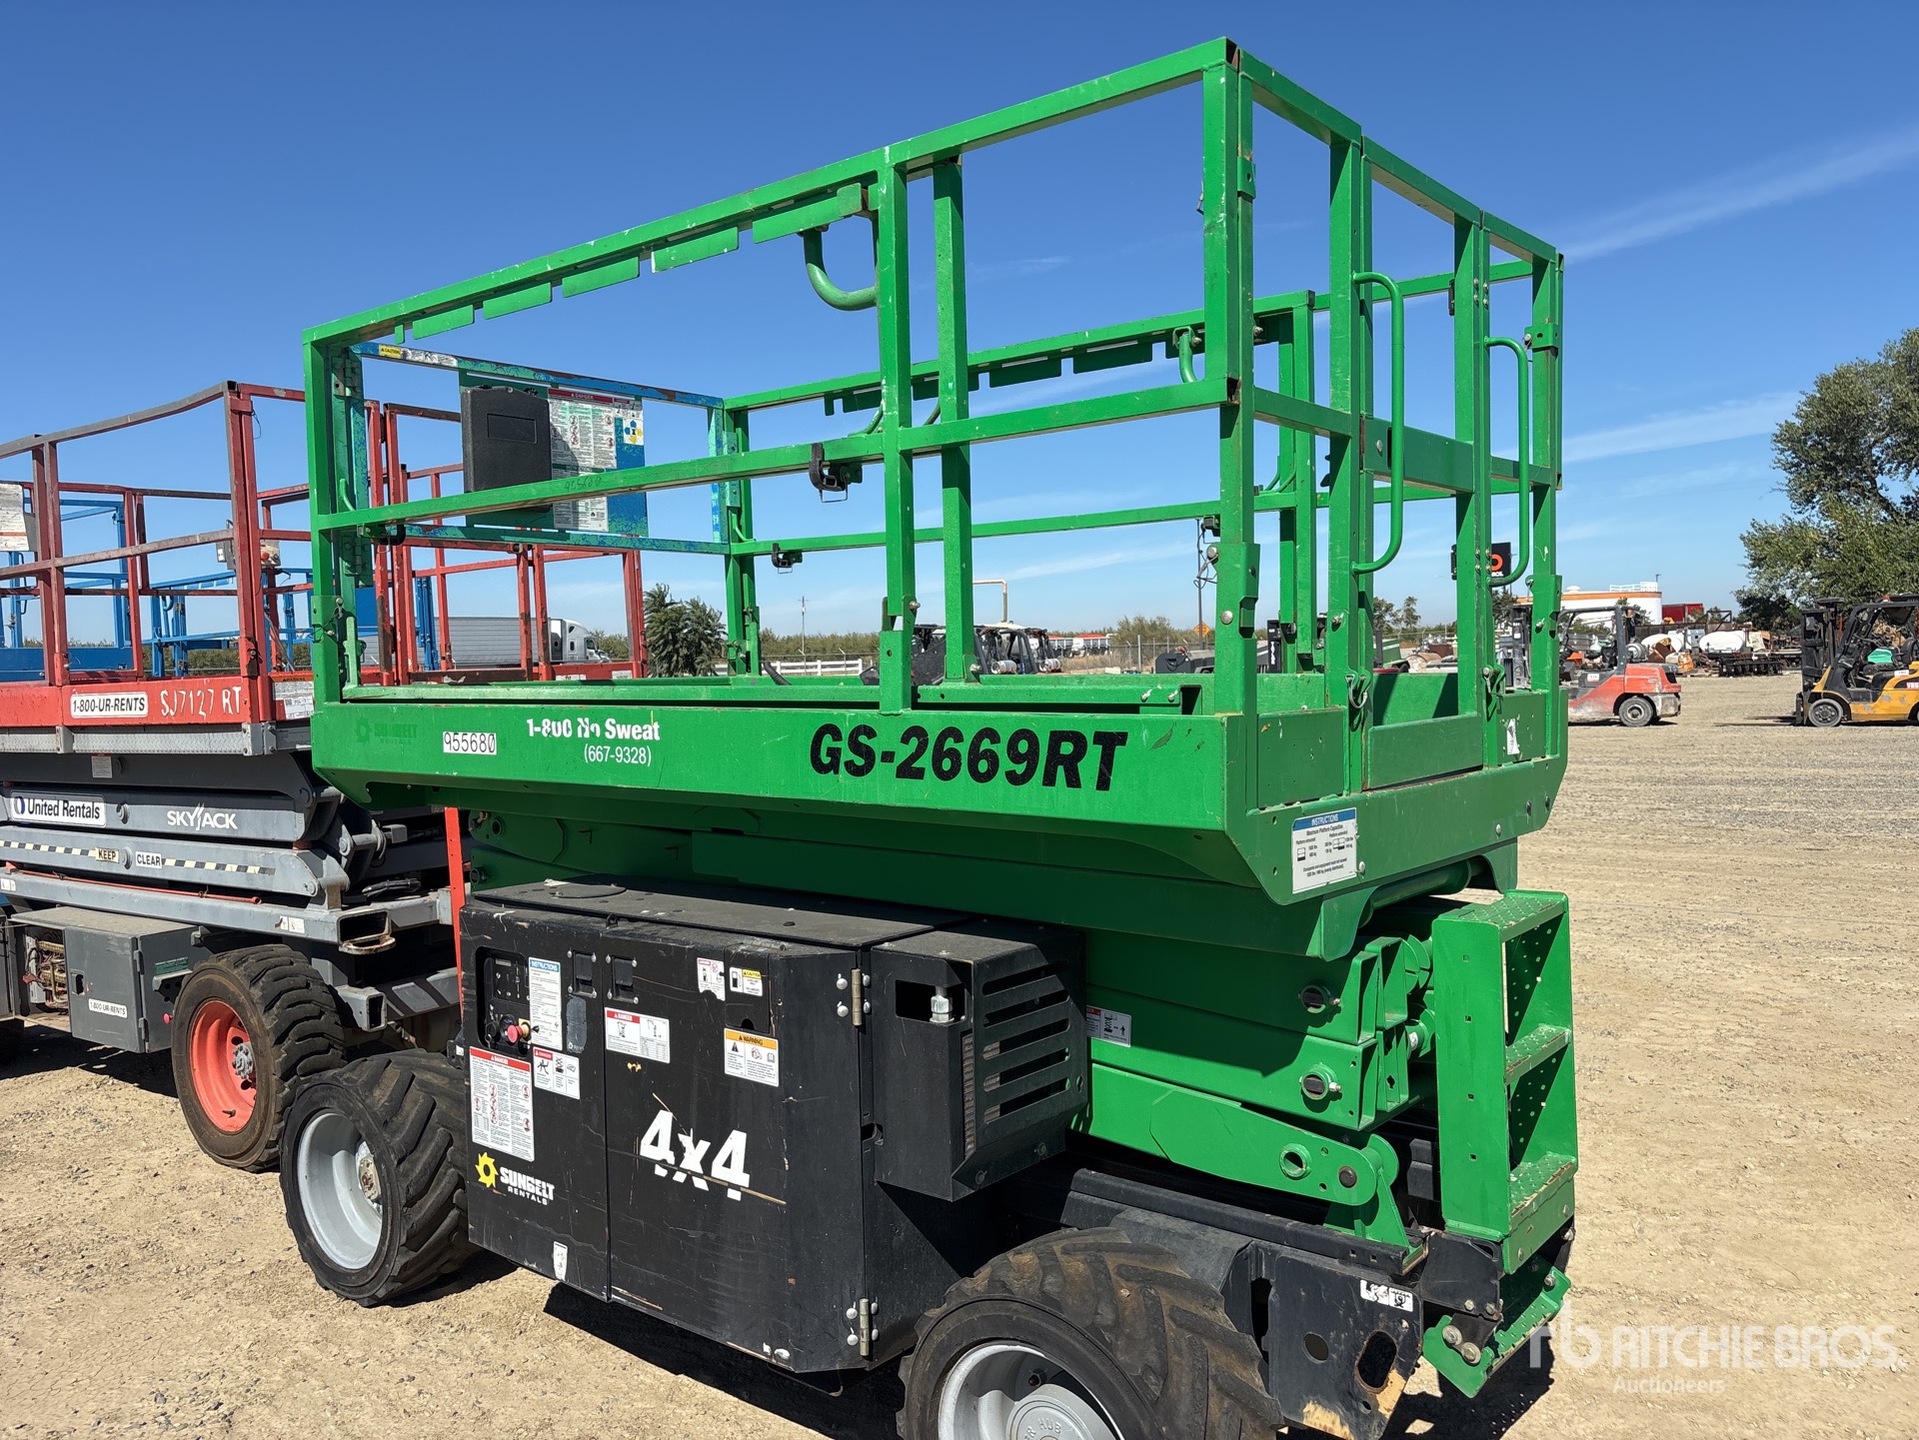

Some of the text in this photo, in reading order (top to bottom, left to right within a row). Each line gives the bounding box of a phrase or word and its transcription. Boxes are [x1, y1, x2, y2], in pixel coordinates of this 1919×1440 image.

[73, 697, 146, 713] 1-800-UR-RENTS
[160, 688, 214, 719] SJ7127
[222, 687, 242, 716] RT
[605, 718, 660, 741] Sweat
[444, 733, 496, 753] 955680
[584, 744, 652, 765] (667-9328)
[810, 723, 1129, 791] GS-2669RT
[28, 799, 100, 820] United Rentals
[167, 803, 238, 831] SKYJACK
[1311, 813, 1339, 826] INSTRUCTIONS
[99, 849, 117, 860] KEEP
[137, 853, 161, 867] CLEAR
[743, 1036, 763, 1046] WARNING
[640, 1110, 750, 1201] 4x4
[500, 1167, 555, 1200] SUNBELT
[507, 1185, 548, 1206] RENTALS
[1038, 1417, 1062, 1434] HUB
